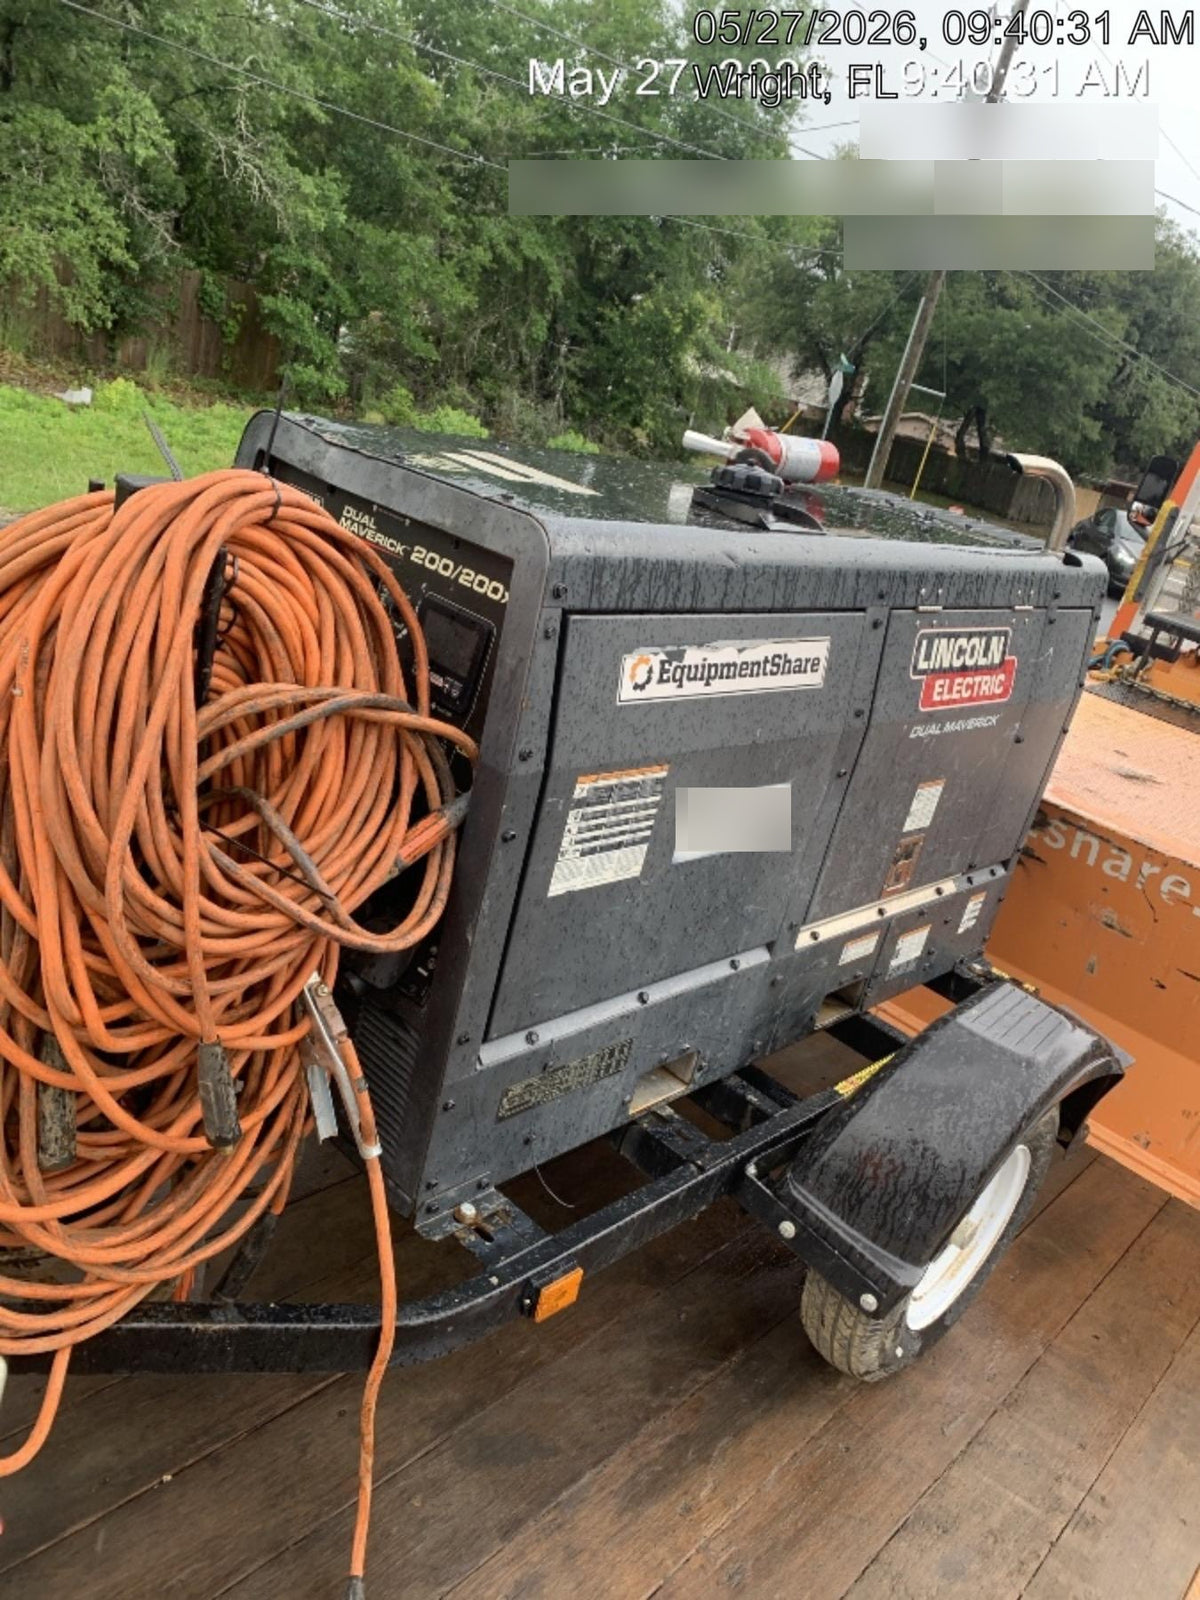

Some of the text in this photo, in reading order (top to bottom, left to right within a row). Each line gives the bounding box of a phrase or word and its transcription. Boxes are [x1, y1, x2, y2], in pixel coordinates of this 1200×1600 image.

[343, 505, 376, 530] DUAL
[340, 516, 404, 556] MAVERICK
[917, 636, 1005, 670] LINCOLN
[656, 653, 821, 689] EquipmentShare
[932, 673, 1006, 702] ELECTRIC
[909, 722, 941, 739] DUAL
